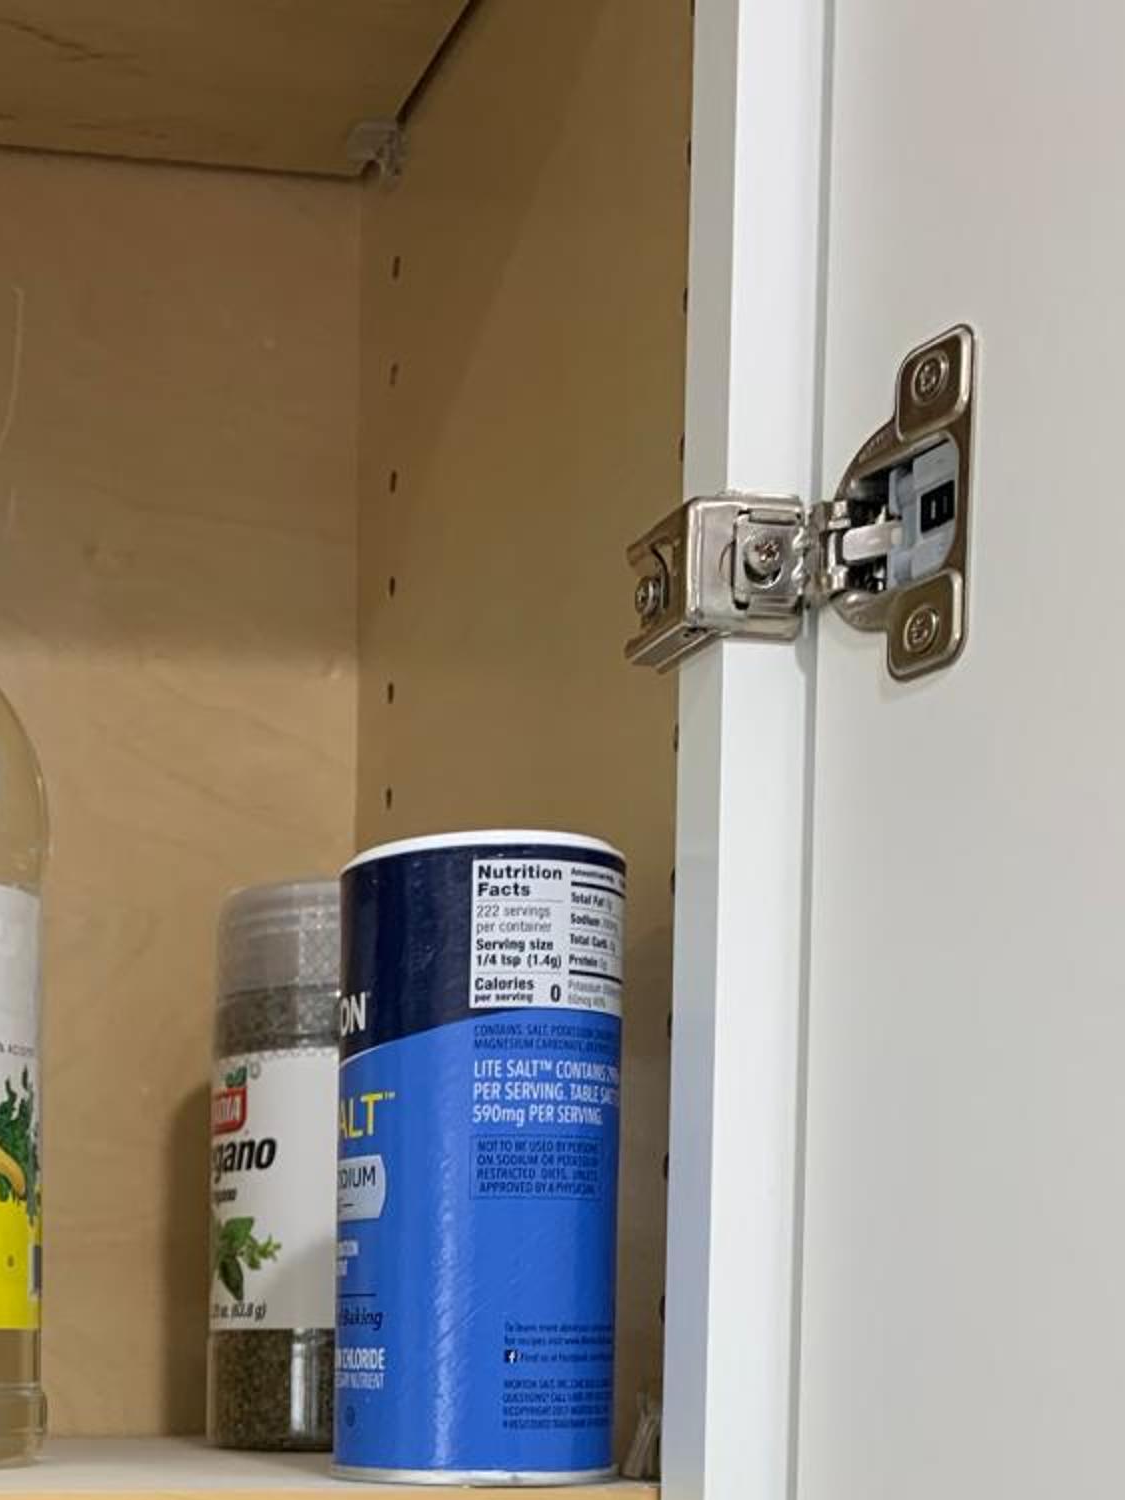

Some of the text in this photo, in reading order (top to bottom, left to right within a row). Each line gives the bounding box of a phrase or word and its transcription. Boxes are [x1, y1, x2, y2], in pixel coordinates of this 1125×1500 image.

[478, 864, 562, 880] Nutrition
[478, 882, 531, 897] Facts
[476, 905, 551, 919] 222 servings
[476, 920, 552, 934] per container
[476, 938, 554, 952] Serving size
[476, 954, 562, 968] 1/4 tsp (1.4g)
[475, 977, 535, 991] Calories
[550, 984, 562, 1002] 0
[475, 992, 533, 1003] per serving
[474, 1060, 502, 1078] LITE
[474, 1082, 500, 1100] PER
[473, 1104, 554, 1127] 590mg PER
